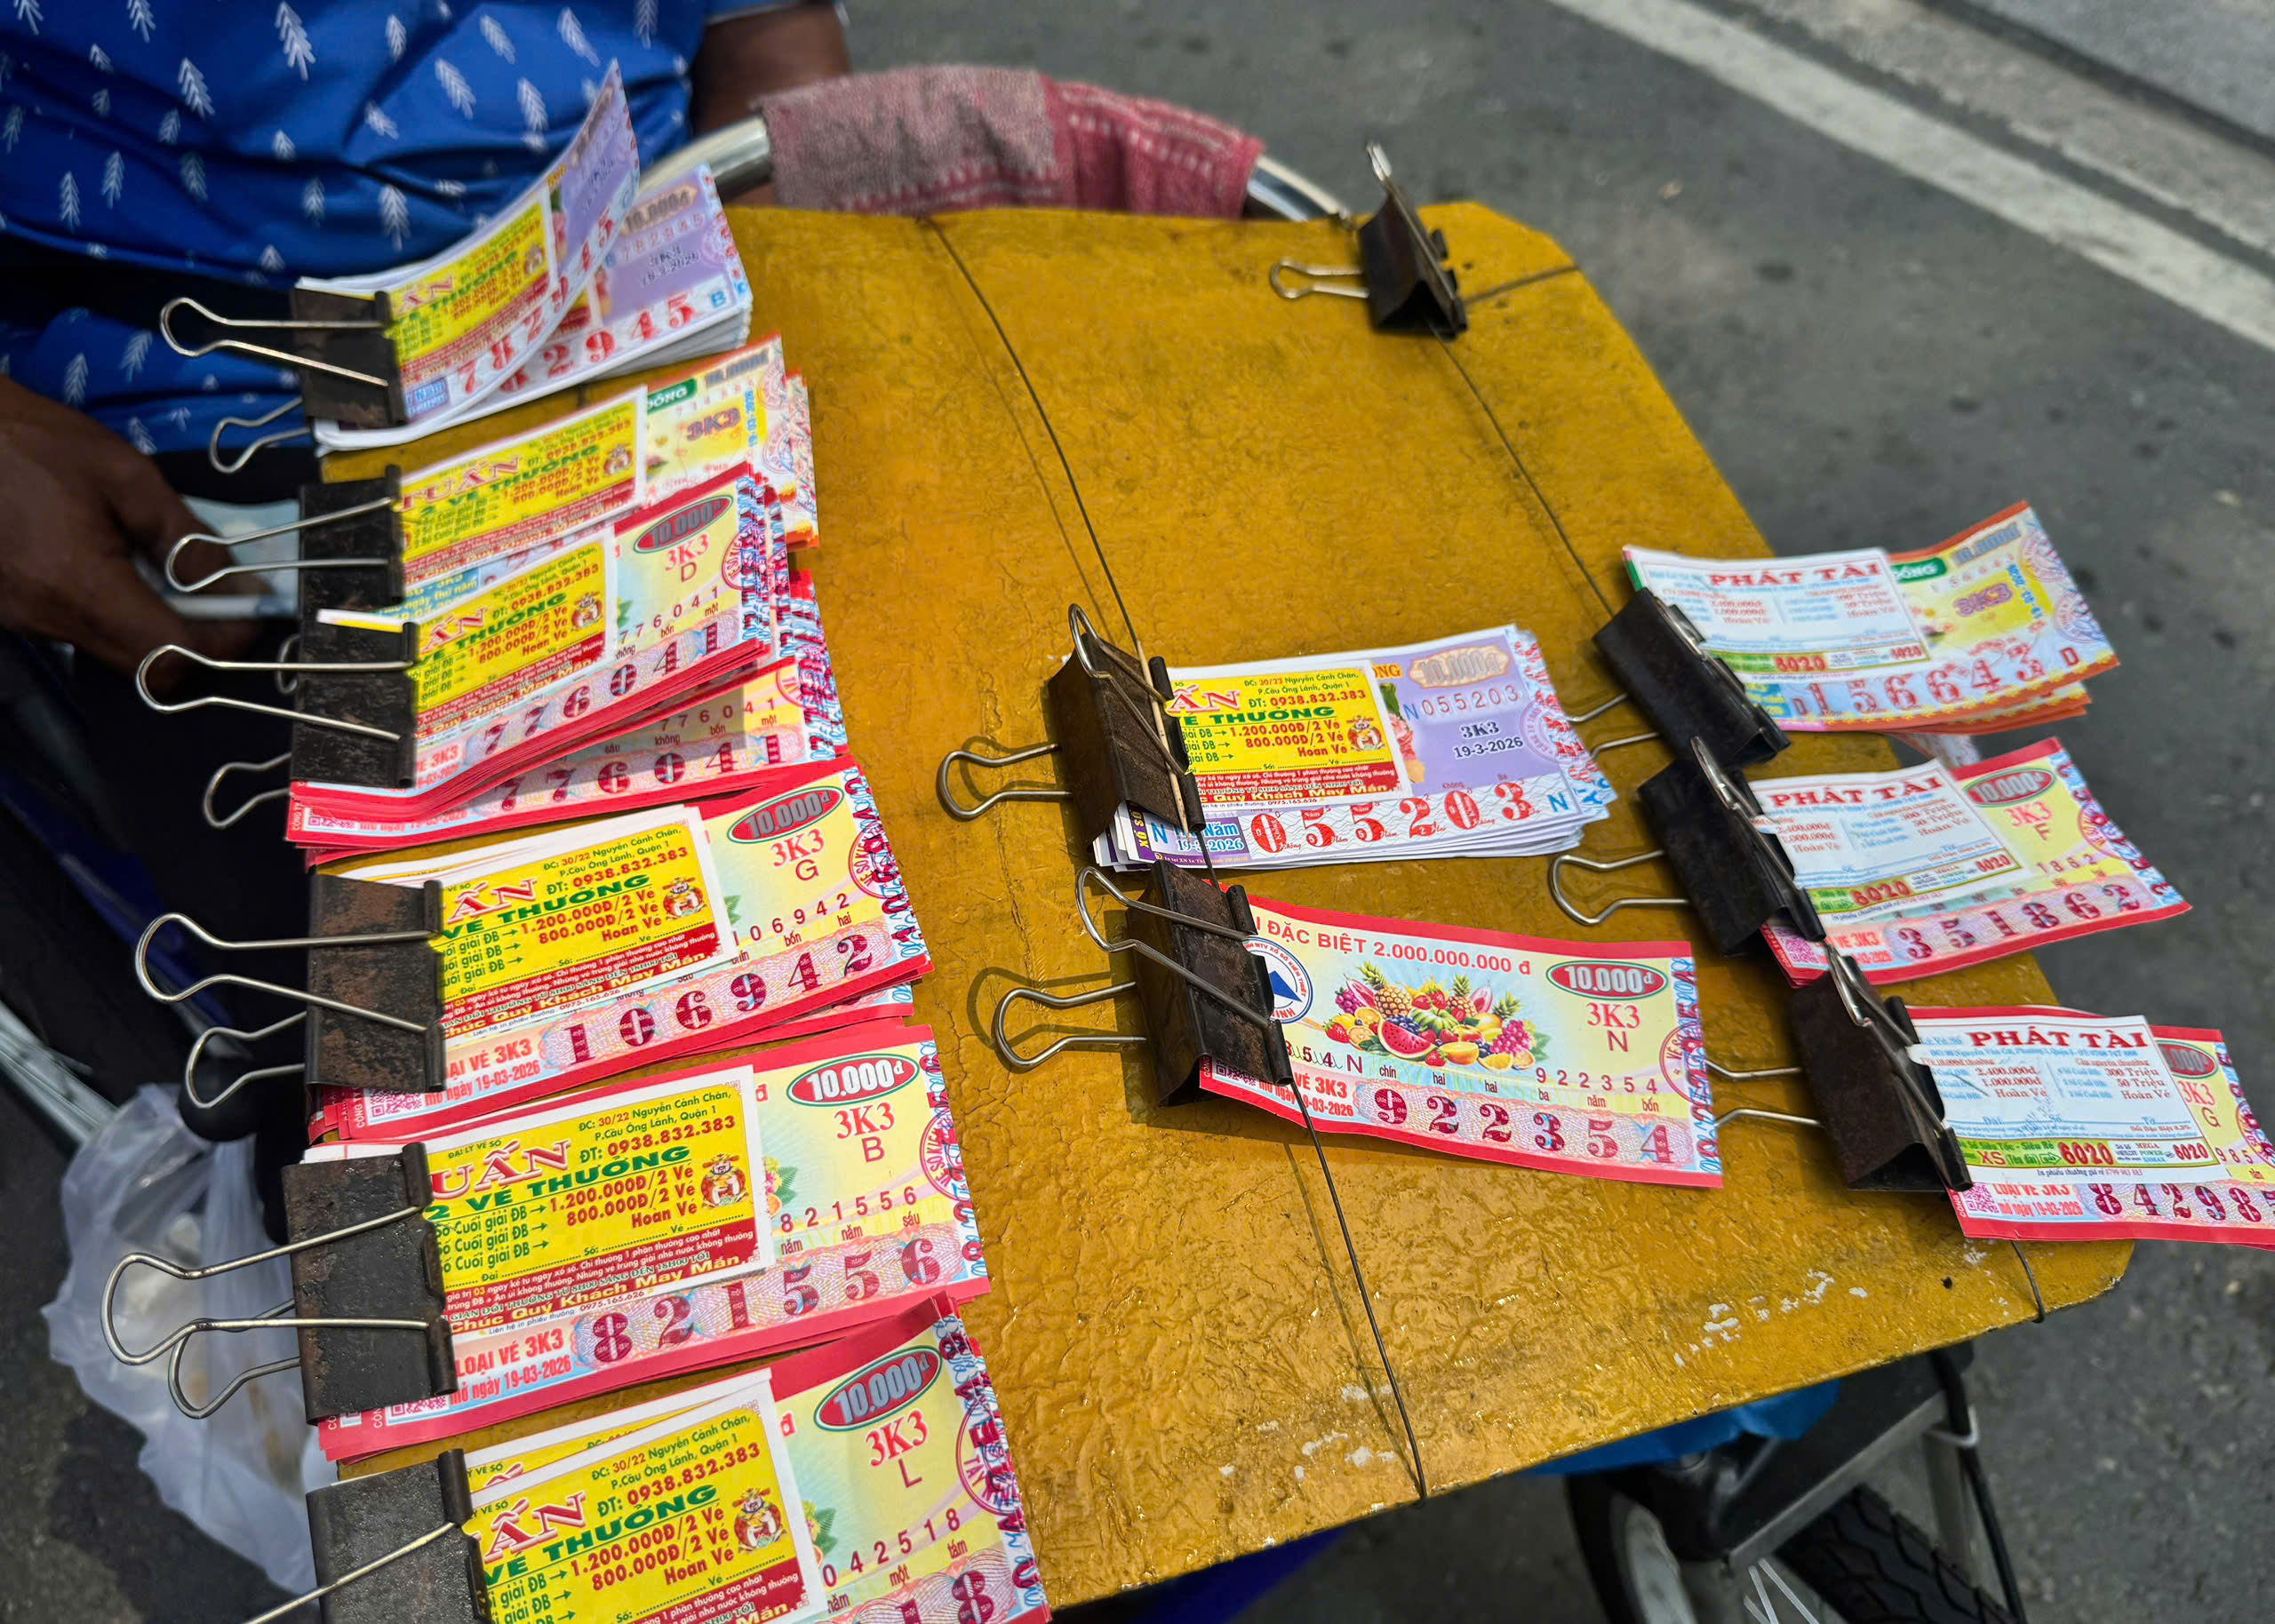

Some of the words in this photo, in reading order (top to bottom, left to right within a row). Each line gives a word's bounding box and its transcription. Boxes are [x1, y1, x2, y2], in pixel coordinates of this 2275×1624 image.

[665, 533, 709, 571] 3K3
[511, 563, 599, 612] 0938.832.383
[681, 561, 697, 584] D
[1707, 569, 1804, 587] PHÁT
[1813, 560, 1882, 579] TÀI
[483, 620, 722, 757] 776041
[1807, 652, 2045, 719] 156643
[2060, 646, 2081, 669] D
[1249, 697, 1266, 708] ĐT:
[1270, 689, 1366, 707] 0938.832.383
[1403, 703, 1419, 721] N
[1422, 685, 1519, 717] 055203
[659, 697, 777, 732] 776041
[1198, 727, 1213, 738] ĐB
[1230, 720, 1322, 738] 1.200.000Đ/2
[1209, 705, 1336, 724] THƯỞNG
[1460, 720, 1500, 738] 3K3
[1202, 739, 1217, 751] ĐB
[1245, 733, 1326, 749] 800.000Đ/2
[1206, 751, 1219, 762] ĐB
[1454, 736, 1524, 759] 19-3-2026
[501, 734, 787, 812] 776041
[1251, 790, 1303, 801] Khách
[1308, 787, 1345, 800] May
[1768, 783, 1864, 808] PHÁT
[1872, 776, 1944, 800] TÀI
[1250, 781, 1534, 855] 055203
[1547, 792, 1569, 813] N
[2002, 800, 2052, 830] 3K3
[770, 828, 825, 867] 3K3
[1151, 823, 1168, 844] N
[1204, 822, 1238, 836] Năm
[2032, 823, 2052, 843] F
[562, 852, 591, 866] 30/22
[572, 846, 688, 888] 0938.832.383
[795, 858, 818, 881] G
[498, 872, 651, 924] THƯỞNG
[521, 892, 631, 935] 1.200.000Đ/2
[539, 907, 635, 945] 800.000Đ/2
[784, 932, 802, 947] bốn
[837, 912, 852, 927] hai
[1897, 882, 2142, 960] 351862
[483, 931, 499, 943] ĐB
[486, 945, 502, 958] ĐB
[1267, 920, 1310, 944] ĐẶC
[1317, 932, 1367, 955] BIỆT
[1373, 940, 1512, 974] 2.000.000.000
[1518, 960, 1531, 975] đ
[489, 959, 505, 972] ĐB
[1564, 966, 1654, 995] 10.000đ
[561, 933, 874, 1069] 106942
[1585, 1002, 1640, 1030] 3K3
[494, 1039, 532, 1063] 3K3
[1606, 1030, 1629, 1053] N
[1966, 1025, 2070, 1047] PHÁT
[2079, 1029, 2149, 1048] TÀI
[475, 1060, 541, 1092] 19-03-2026
[1346, 1055, 1363, 1074] N
[806, 1059, 906, 1103] 10.000đ
[1314, 1077, 1347, 1098] 3K3
[1378, 1063, 1397, 1079] chín
[1433, 1071, 1446, 1086] hai
[1484, 1079, 1498, 1093] hai
[1537, 1088, 1550, 1102] ba
[1587, 1094, 1607, 1109] năm
[1641, 1099, 1660, 1112] bốn
[1536, 1067, 1656, 1095] 922354
[2178, 1080, 2215, 1105] 3K3
[579, 1118, 595, 1132] ĐC:
[598, 1111, 630, 1128] 30/22
[626, 1118, 648, 1138] Ông
[680, 1108, 710, 1125] Quận
[834, 1102, 895, 1140] 3K3
[1373, 1087, 1676, 1165] 922354
[2201, 1106, 2221, 1127] G
[579, 1147, 603, 1164] ĐT:
[608, 1115, 736, 1156] 0938.832.383
[861, 1135, 885, 1163] B
[2057, 1141, 2114, 1166] 6020
[2173, 1142, 2209, 1160] 6020
[527, 1145, 691, 1197] THƯỞNG
[1976, 1150, 2007, 1166] XS
[550, 1168, 669, 1213] 1.200.000Đ/2
[675, 1165, 694, 1180] Vé
[566, 1186, 670, 1227] 800.000Đ/2
[678, 1182, 696, 1198] Vé
[485, 1208, 507, 1232] giải
[511, 1206, 527, 1222] ĐB
[631, 1207, 672, 1229] Hoàn
[679, 1201, 698, 1218] Vé
[779, 1185, 918, 1233] 821556
[486, 1227, 508, 1250] giải
[512, 1223, 529, 1239] ĐB
[781, 1238, 803, 1255] năm
[842, 1223, 863, 1241] năm
[902, 1210, 921, 1227] sáu
[488, 1245, 510, 1269] giải
[514, 1242, 530, 1258] ĐB
[560, 1284, 627, 1309] Khách
[635, 1271, 683, 1292] May
[579, 1291, 645, 1312] 0975.165.626
[590, 1236, 942, 1365] 821556
[455, 1350, 496, 1379] LOẠI
[499, 1338, 521, 1359] VÉ
[525, 1327, 564, 1357] 3K3
[472, 1371, 501, 1402] ngày
[504, 1354, 572, 1390] 19-03-2026
[866, 1409, 929, 1468] 3K3
[591, 1467, 611, 1481] ĐC:
[612, 1453, 646, 1473] 30/22
[643, 1461, 667, 1481] Ông
[699, 1439, 730, 1459] Quận
[898, 1458, 923, 1489] L
[597, 1497, 622, 1517] ĐT:
[627, 1442, 761, 1506] 0938.832.383
[542, 1484, 717, 1561] THƯỞNG
[571, 1514, 697, 1577] 1.200.000Đ/2
[703, 1504, 724, 1524] Vé
[821, 1508, 961, 1588] 042518
[591, 1535, 703, 1592] 800.000Đ/2
[706, 1524, 730, 1546] Vé
[663, 1557, 706, 1586] Hoàn
[711, 1544, 735, 1565] Vé
[889, 1568, 911, 1587] một
[947, 1539, 969, 1559] tám
[528, 1572, 547, 1592] ĐB
[532, 1593, 552, 1612] ĐB
